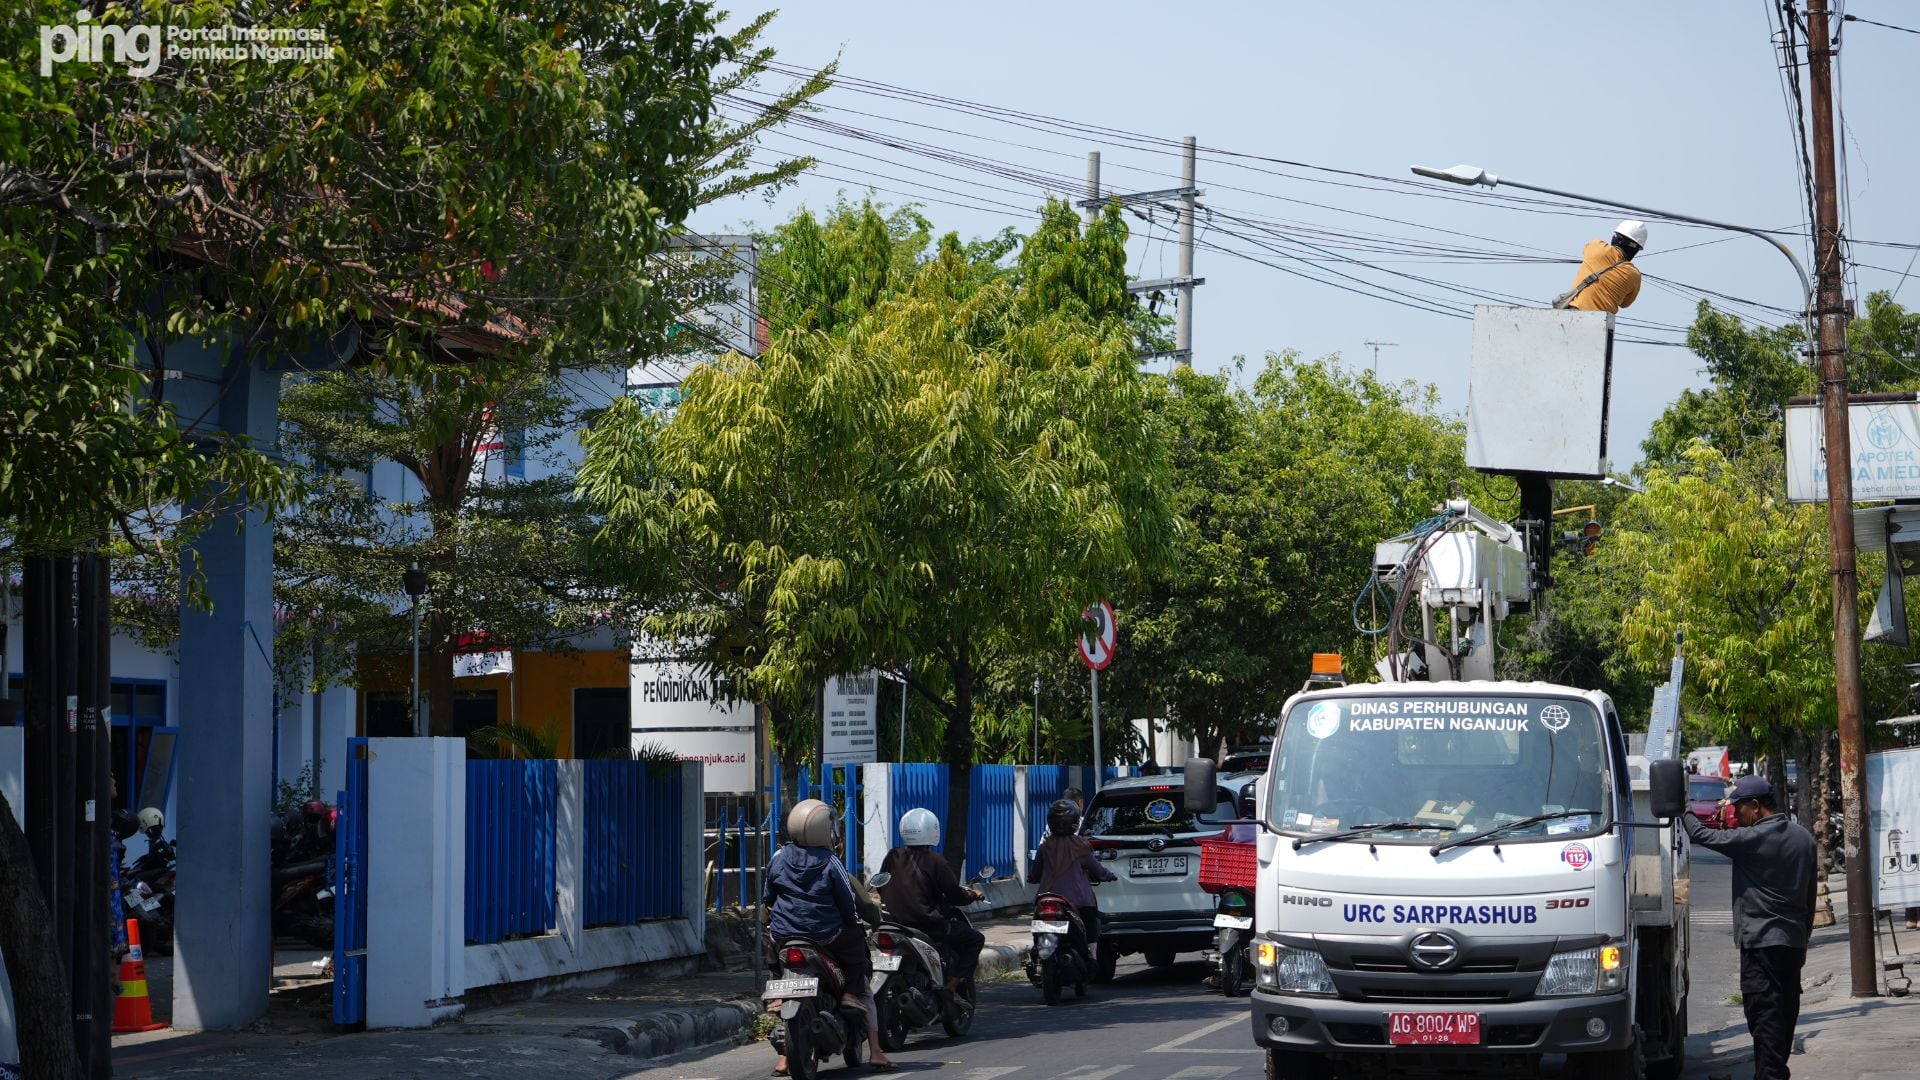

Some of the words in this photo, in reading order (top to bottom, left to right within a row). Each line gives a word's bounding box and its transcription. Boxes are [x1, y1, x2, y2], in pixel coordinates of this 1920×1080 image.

[1857, 450, 1914, 463] APOTEK
[643, 680, 708, 703] PENDIDIKAN
[1351, 702, 1399, 715] DINAS
[1403, 702, 1528, 715] PERHUBUNGAN
[1350, 718, 1445, 731] KABUPATEN
[1449, 718, 1529, 732] NGANJUK
[1132, 859, 1143, 869] AE
[1173, 857, 1185, 868] GS
[1568, 853, 1585, 863] 112
[1283, 895, 1333, 907] HINO
[1545, 898, 1590, 910] 300
[1343, 904, 1386, 923] URC
[1393, 905, 1538, 924] SARPRASHUB
[1392, 1015, 1411, 1033] AG
[1416, 1015, 1453, 1033] 8004
[1457, 1015, 1477, 1033] WP
